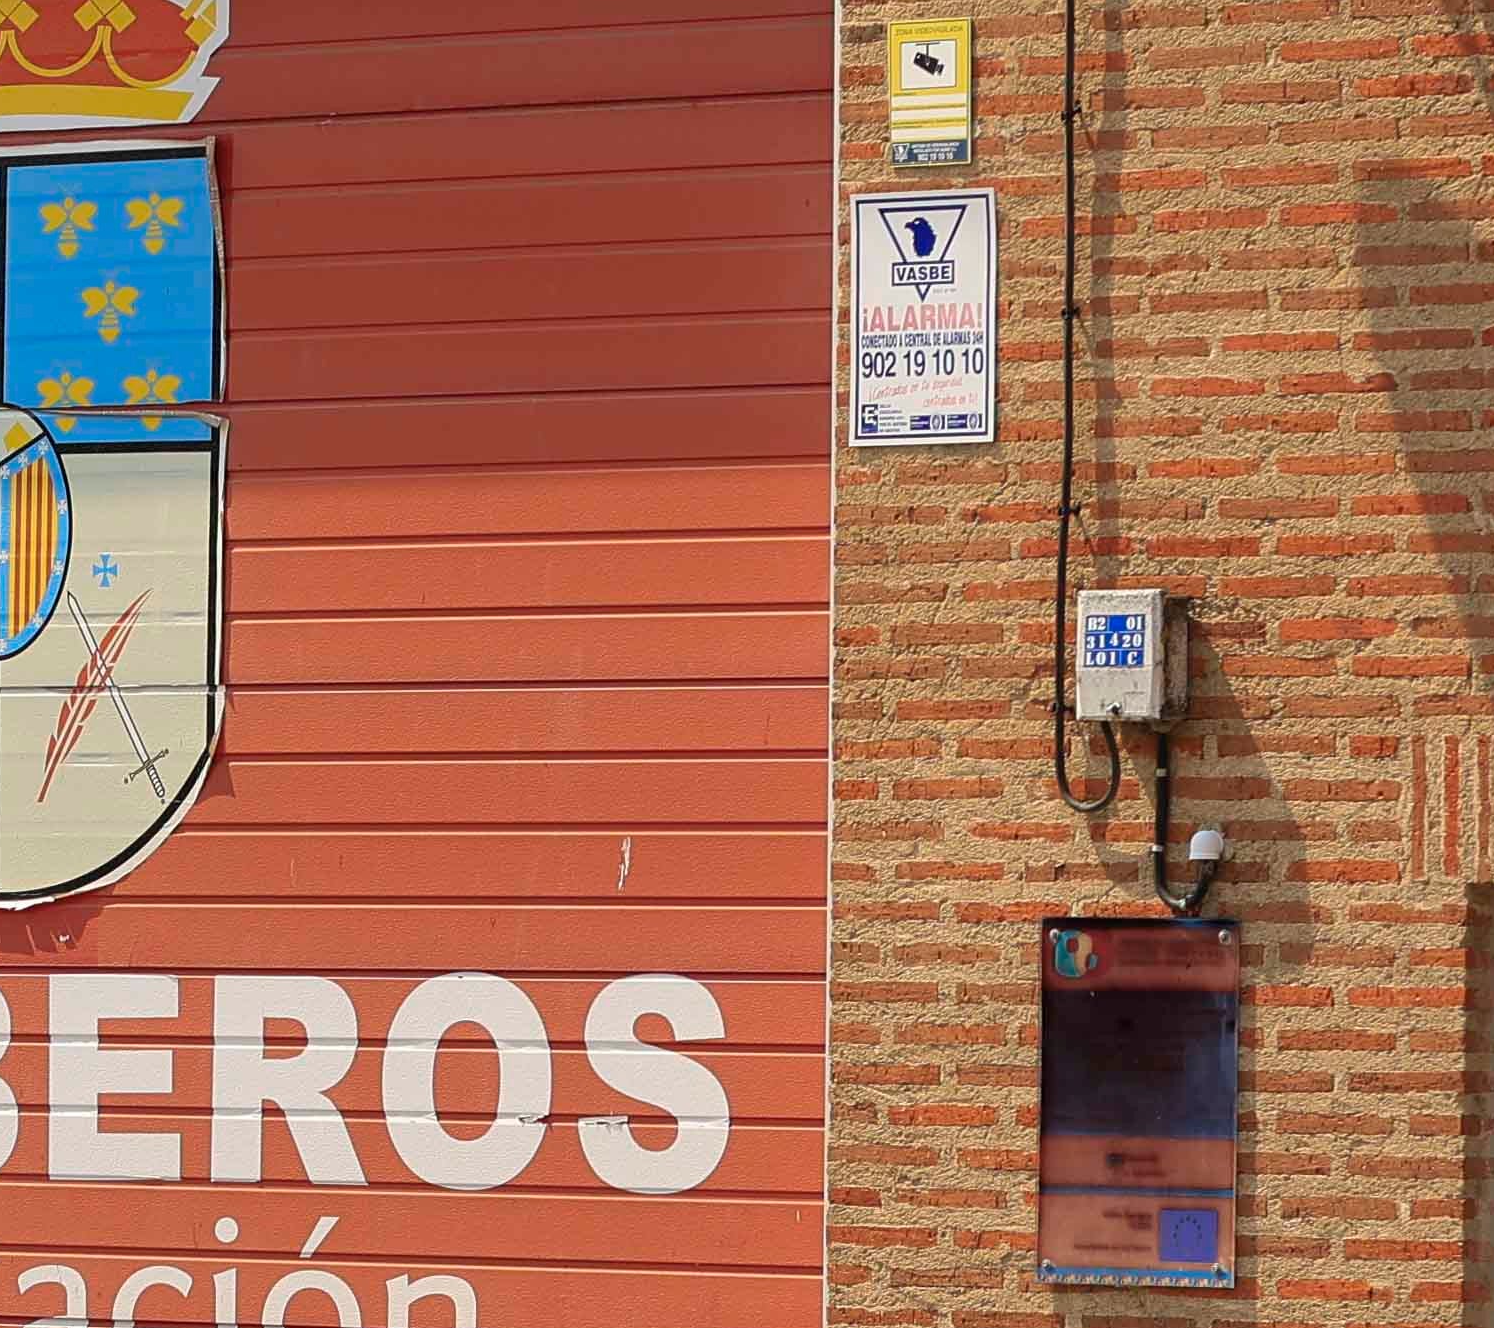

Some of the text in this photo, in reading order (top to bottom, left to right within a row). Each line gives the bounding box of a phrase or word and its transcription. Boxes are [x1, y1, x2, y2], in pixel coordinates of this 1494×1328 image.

[896, 265, 951, 282] VASBE
[862, 302, 983, 333] ¡ALARMA!
[861, 334, 898, 349] CONECTADO
[904, 333, 932, 347] CENTRAL
[933, 332, 941, 346] DE
[861, 348, 984, 378] 902 19 10 10
[1127, 651, 1138, 665] C
